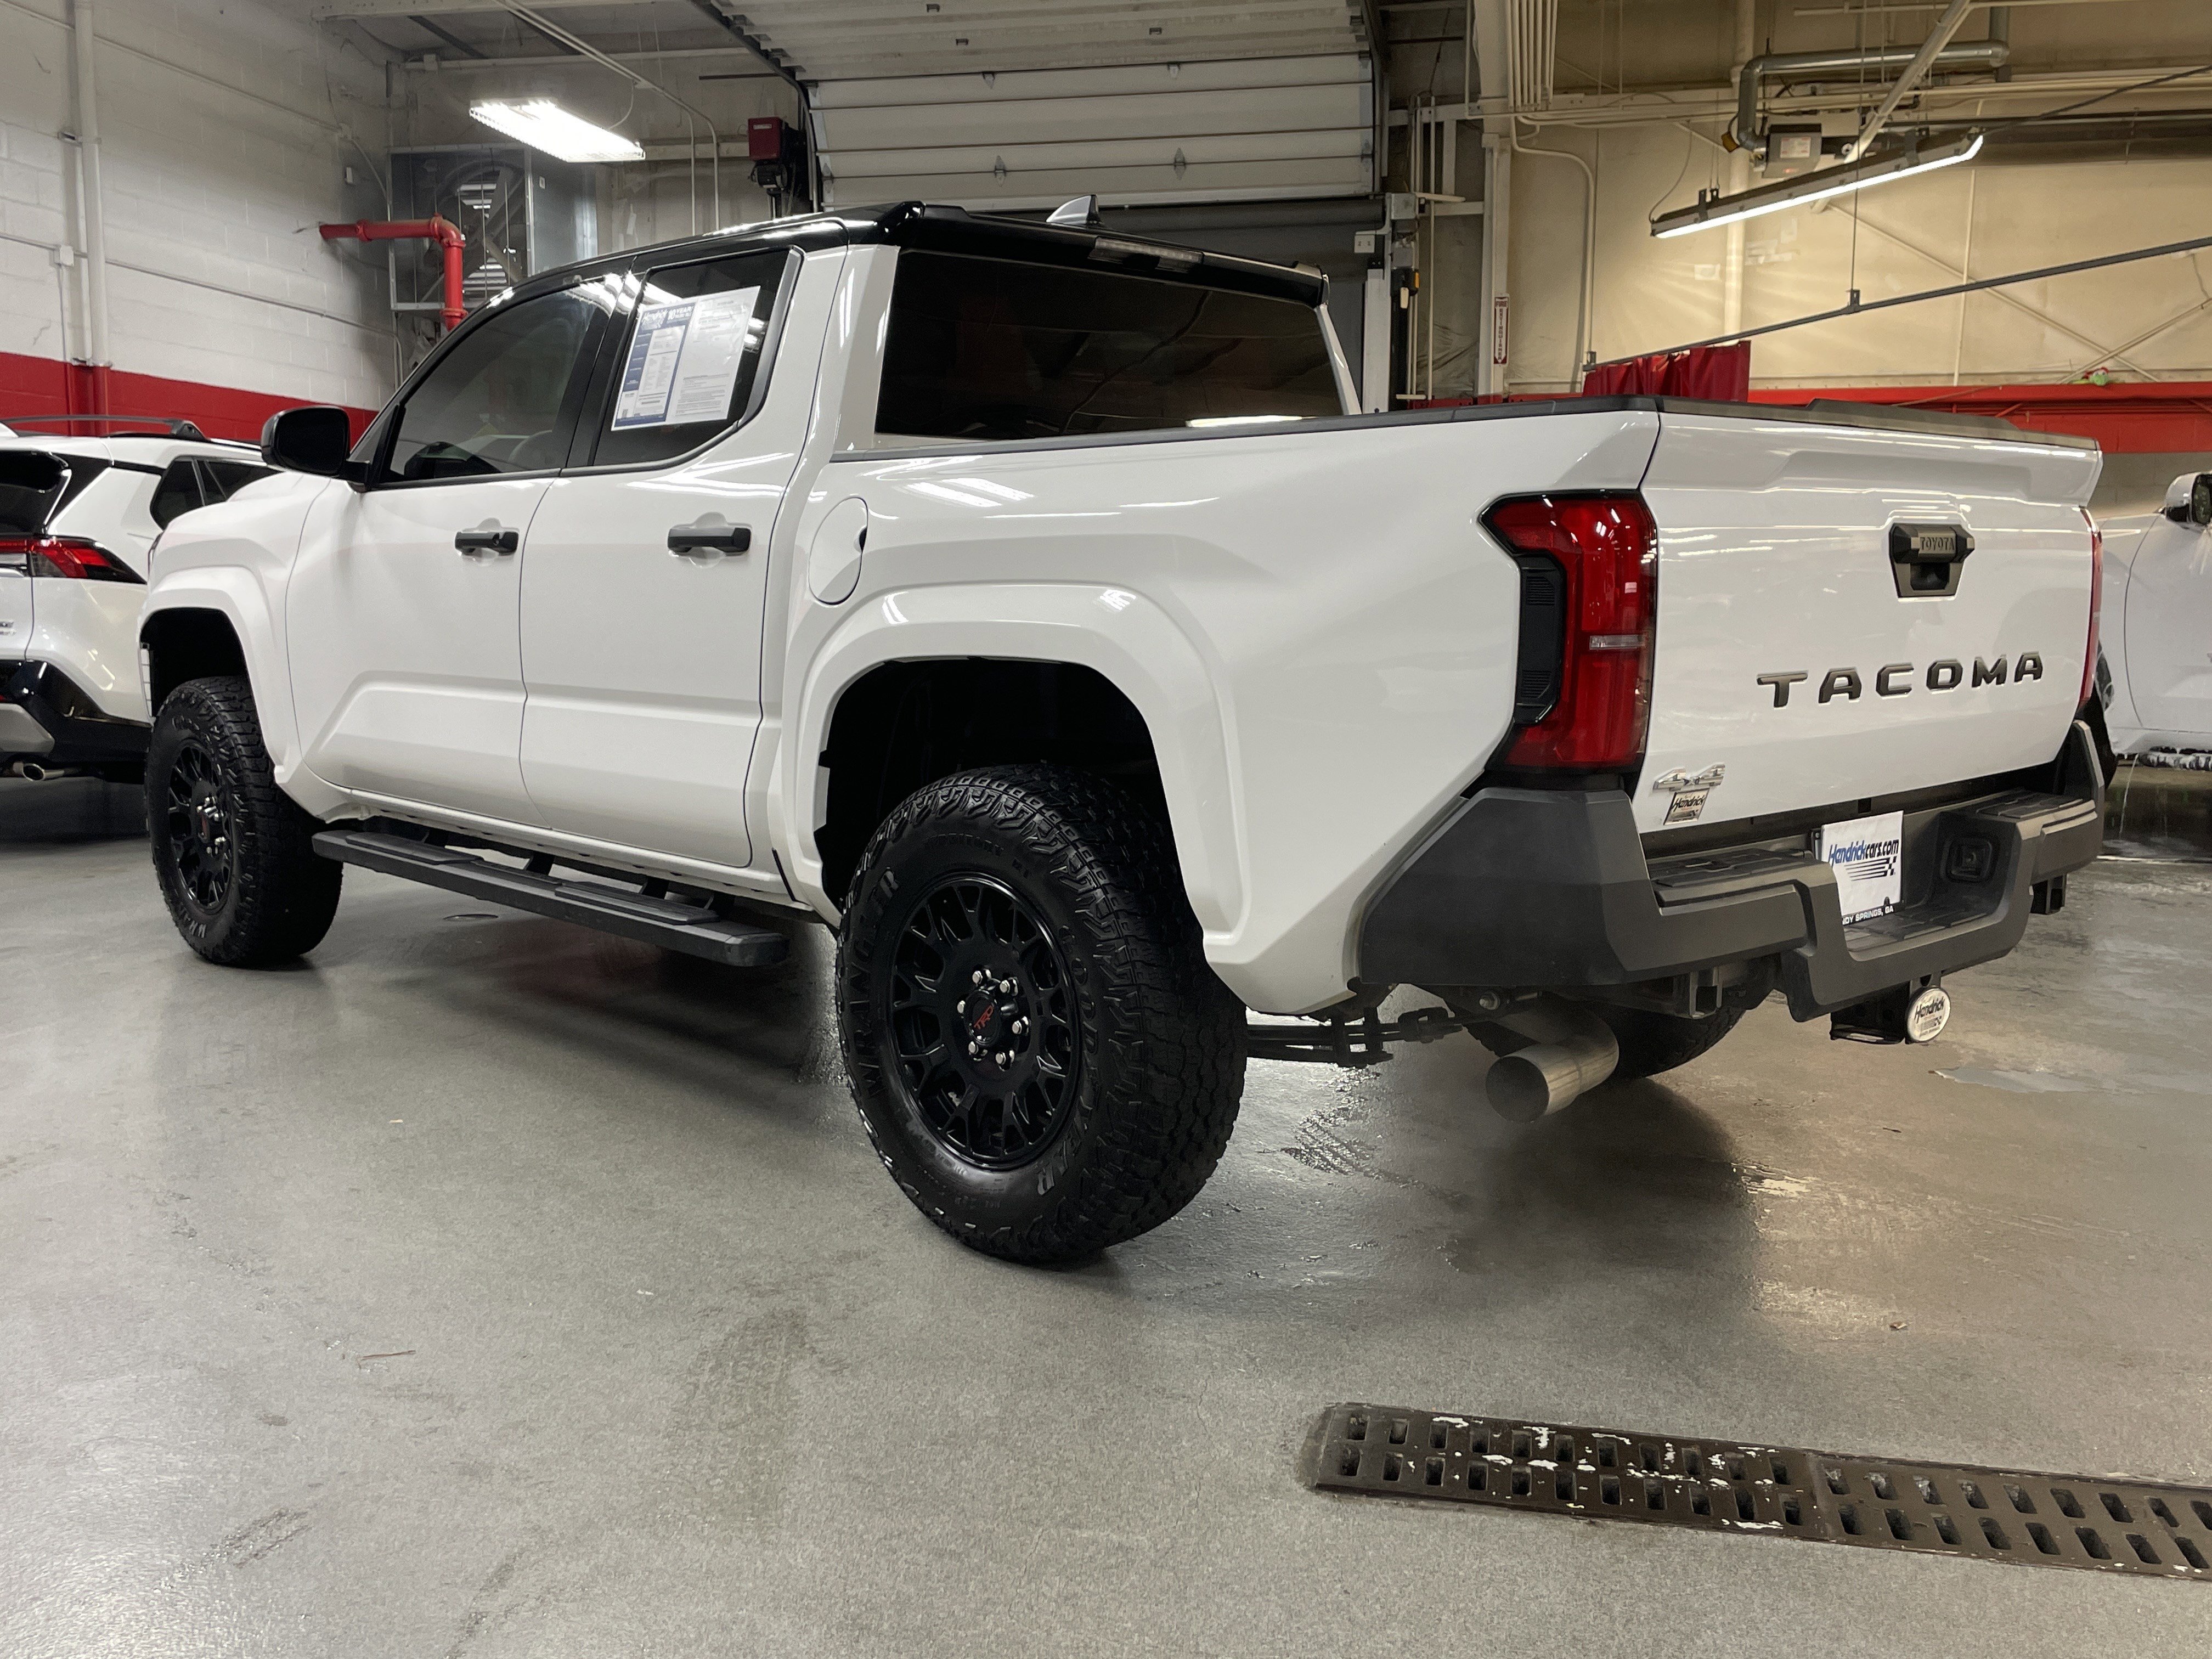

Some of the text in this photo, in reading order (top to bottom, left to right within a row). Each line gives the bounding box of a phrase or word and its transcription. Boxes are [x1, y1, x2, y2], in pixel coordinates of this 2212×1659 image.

[1920, 537, 1955, 550] TOYOTA
[1756, 651, 2043, 708] TACOMA
[1671, 795, 1705, 812] Hendrick
[1828, 839, 1899, 869] Hendrickcars.com
[1855, 908, 1883, 922] SPRINGS,
[1884, 905, 1894, 914] GA
[974, 1005, 994, 1030] TRD
[1914, 996, 1945, 1024] Hendrick
